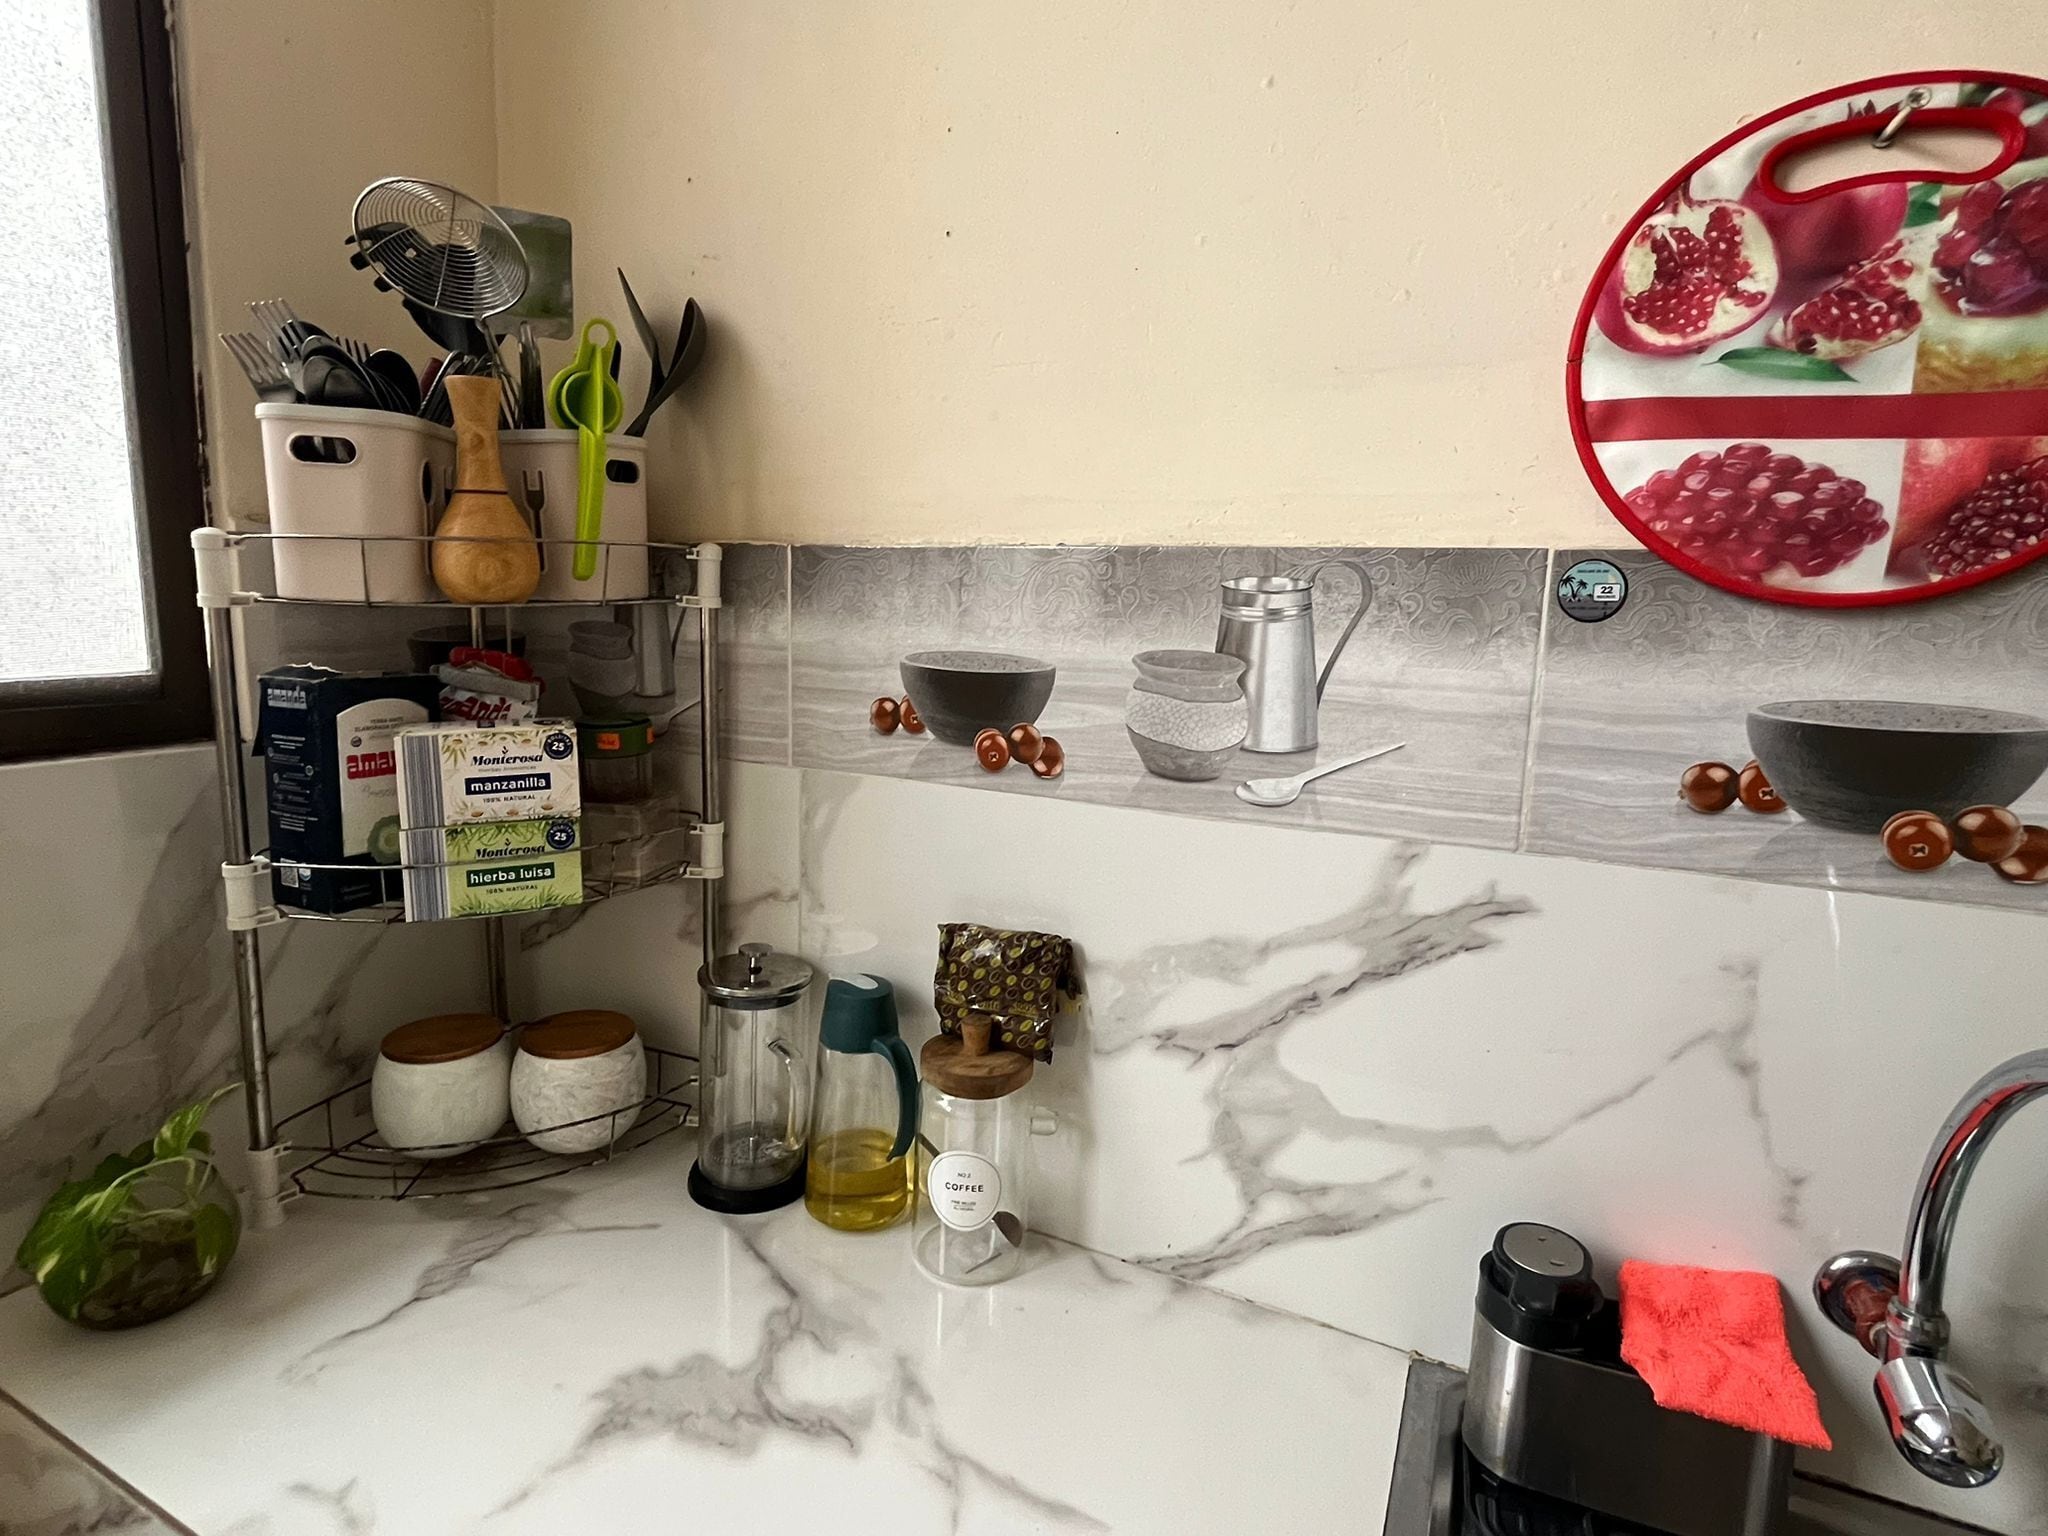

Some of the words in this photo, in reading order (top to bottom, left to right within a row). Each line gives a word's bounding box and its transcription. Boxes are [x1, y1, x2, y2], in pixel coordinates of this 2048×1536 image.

[1600, 586, 1614, 594] 22
[267, 686, 307, 709] amanda
[552, 741, 565, 750] 25
[472, 754, 543, 766] Monterosa
[471, 777, 546, 792] manzanilla
[504, 794, 536, 802] NATURAL
[554, 832, 567, 841] 25
[475, 845, 545, 858] Monterosa
[470, 871, 515, 884] hierba
[520, 866, 552, 879] luisa
[506, 884, 538, 893] NATURAL
[945, 1182, 984, 1192] COFFEE
